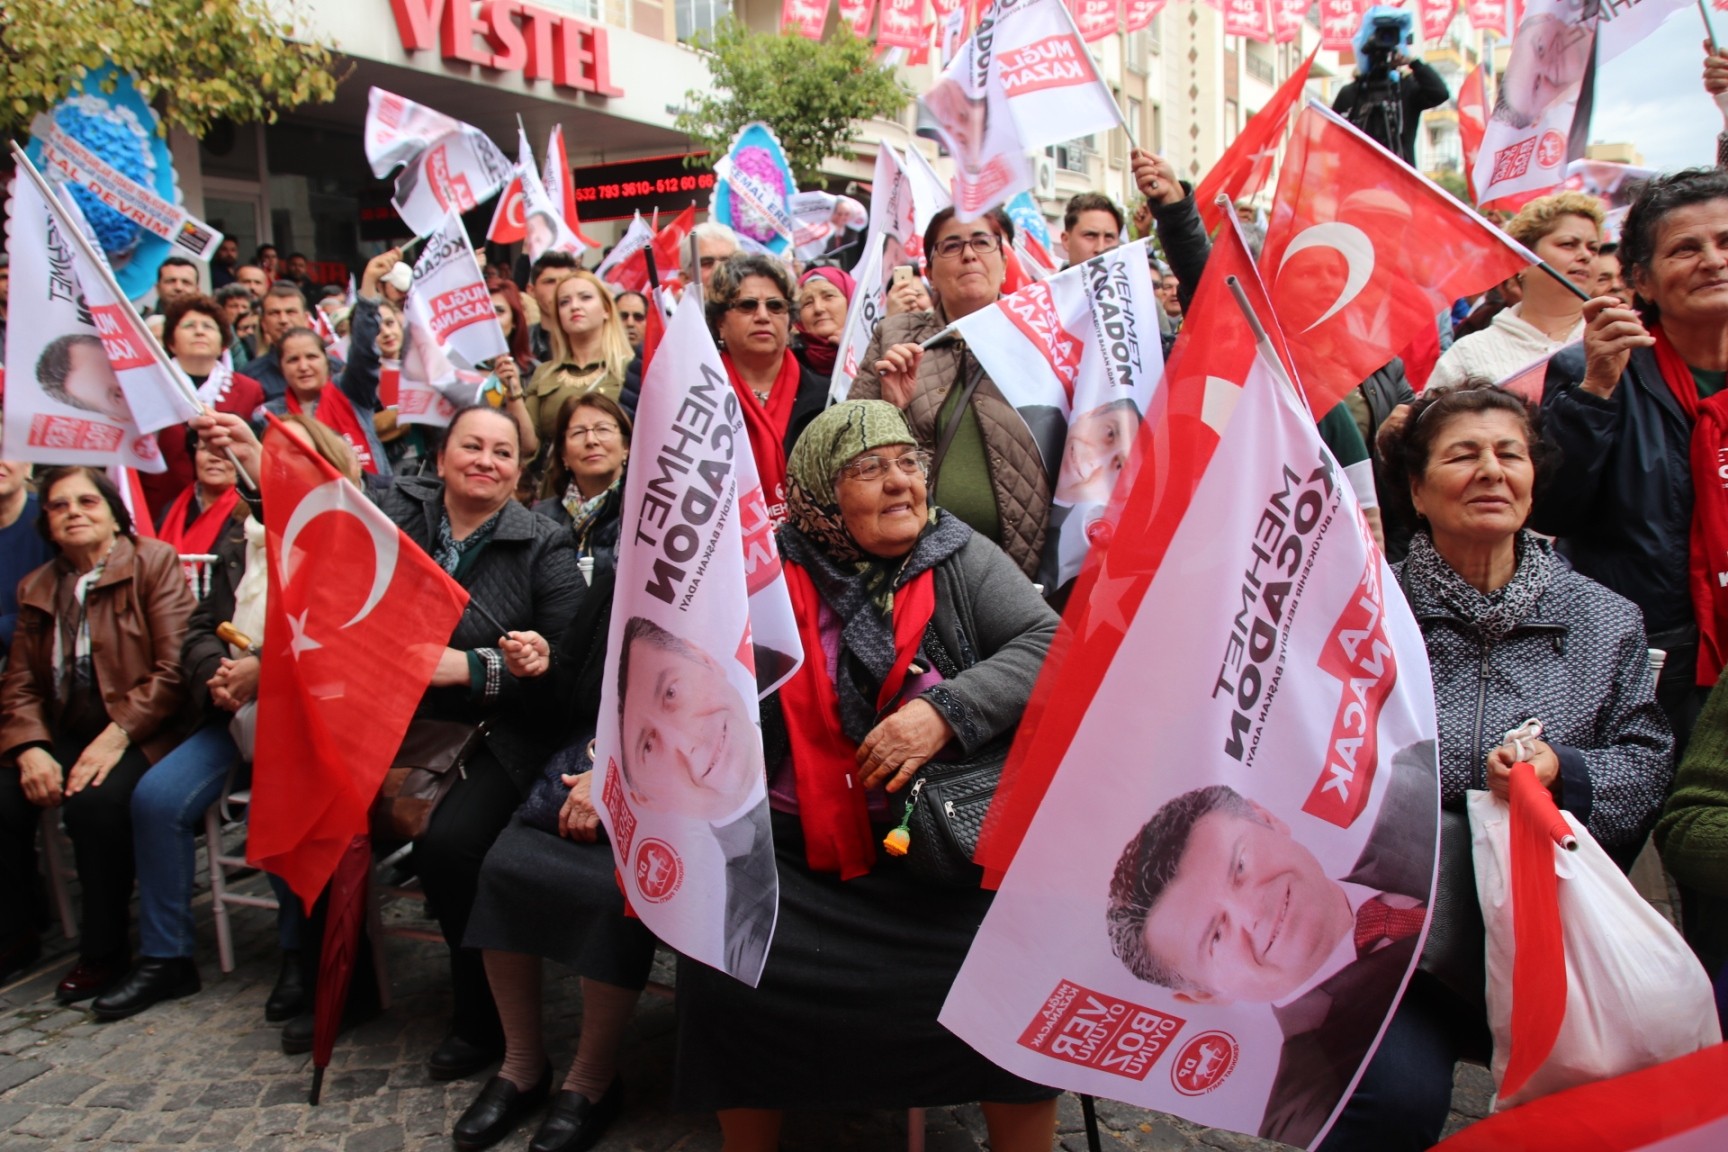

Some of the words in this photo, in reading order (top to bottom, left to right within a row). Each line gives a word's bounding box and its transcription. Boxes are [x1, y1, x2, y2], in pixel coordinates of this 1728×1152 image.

[1086, 0, 1108, 13] DP
[388, 0, 625, 98] VESTEL
[87, 180, 171, 237] DEVRİM
[600, 183, 621, 198] 793
[656, 176, 679, 193] 512
[1028, 283, 1073, 359] MUĞLA
[1112, 261, 1143, 374] MEHMET
